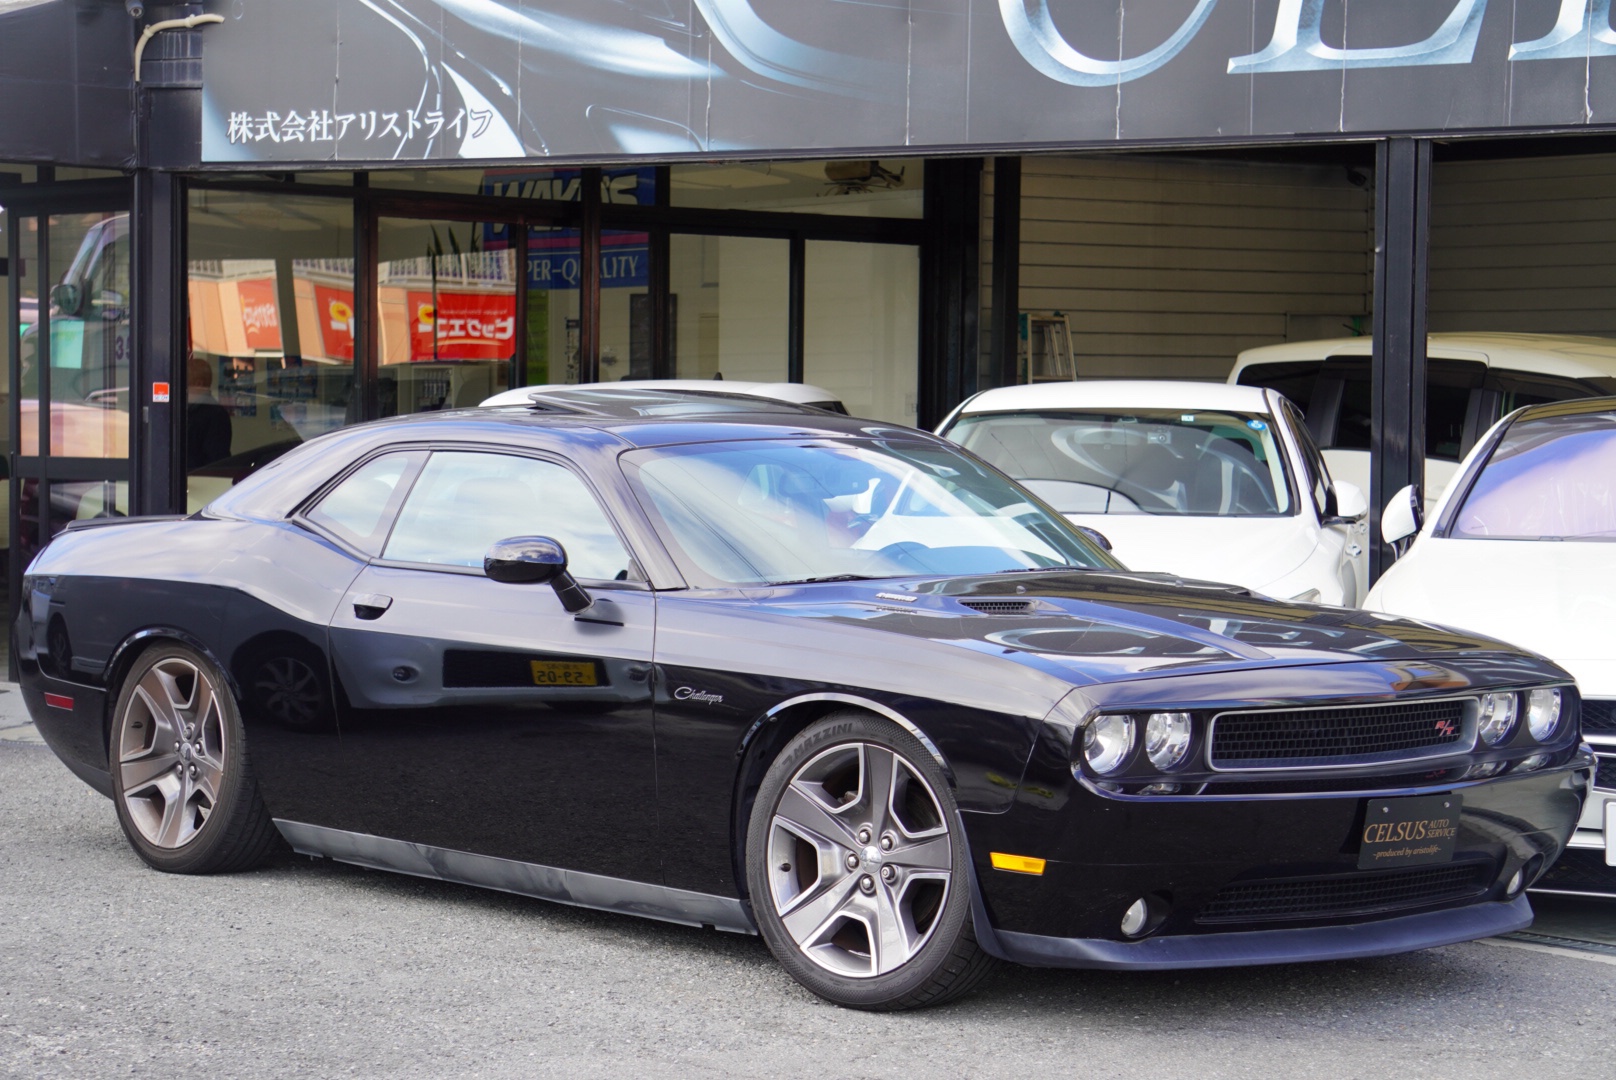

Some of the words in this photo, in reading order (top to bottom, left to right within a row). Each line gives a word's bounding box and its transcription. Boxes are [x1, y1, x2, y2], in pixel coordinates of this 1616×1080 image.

[226, 108, 494, 144] 株式会社アリストライフ
[674, 686, 724, 705] Challenger
[1435, 720, 1454, 737] R/T
[1364, 821, 1428, 843] CELSUS
[1428, 819, 1450, 829] AUTO
[1427, 827, 1456, 838] SERVICE
[1405, 848, 1413, 857] by
